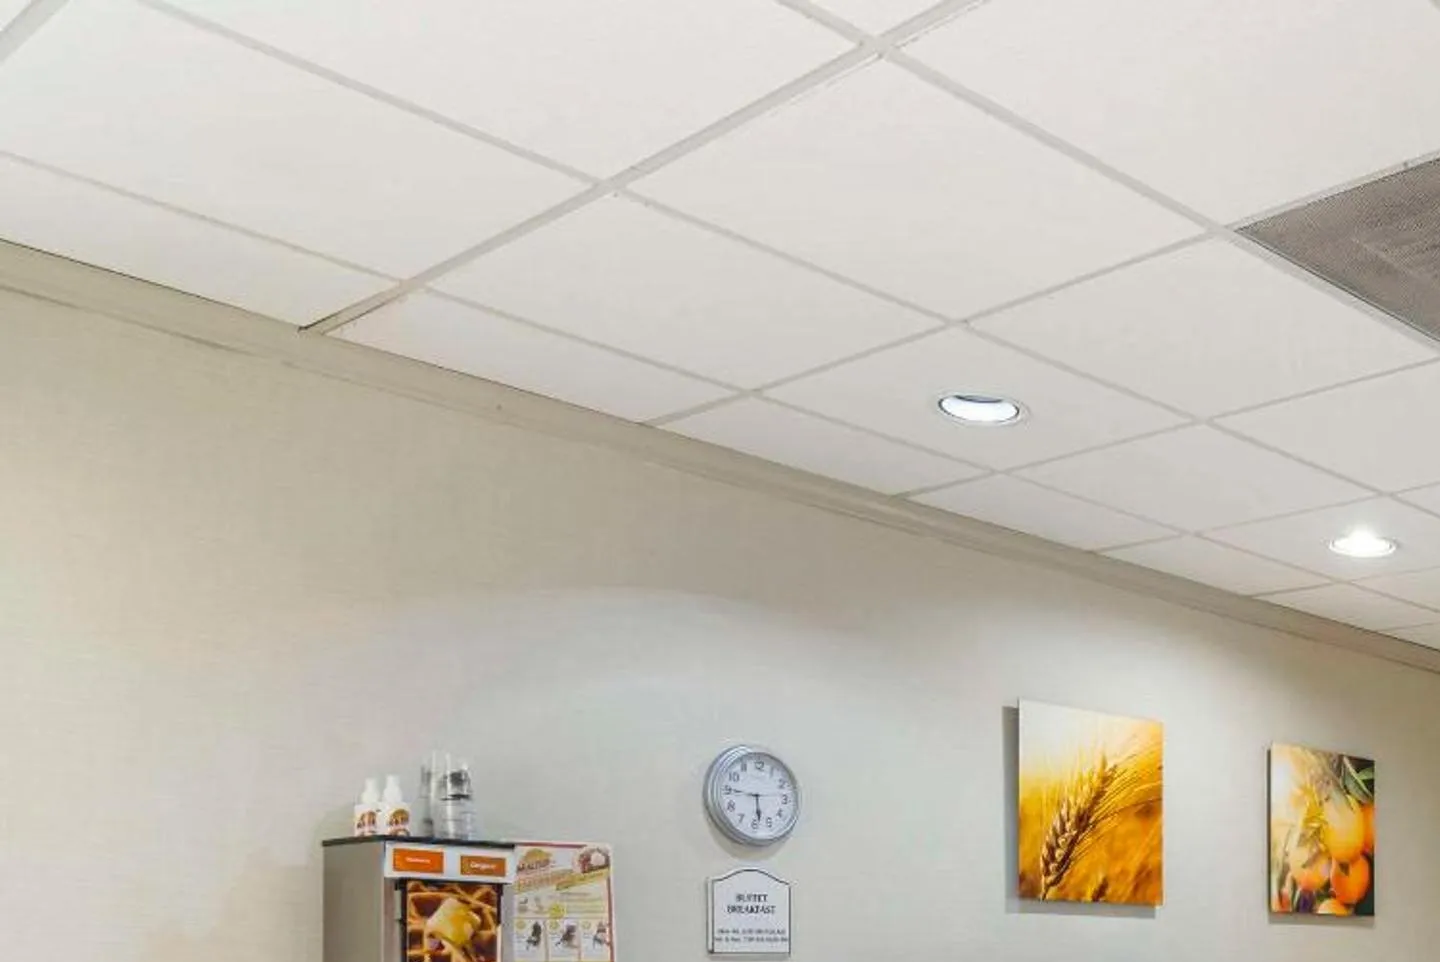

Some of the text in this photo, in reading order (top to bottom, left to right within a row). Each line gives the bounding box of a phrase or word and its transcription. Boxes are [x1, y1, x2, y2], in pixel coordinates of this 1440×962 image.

[754, 760, 765, 772] 12
[728, 771, 740, 782] 10
[781, 794, 788, 805] 3
[727, 800, 735, 812] 8
[727, 905, 776, 914] BREAKFAST
